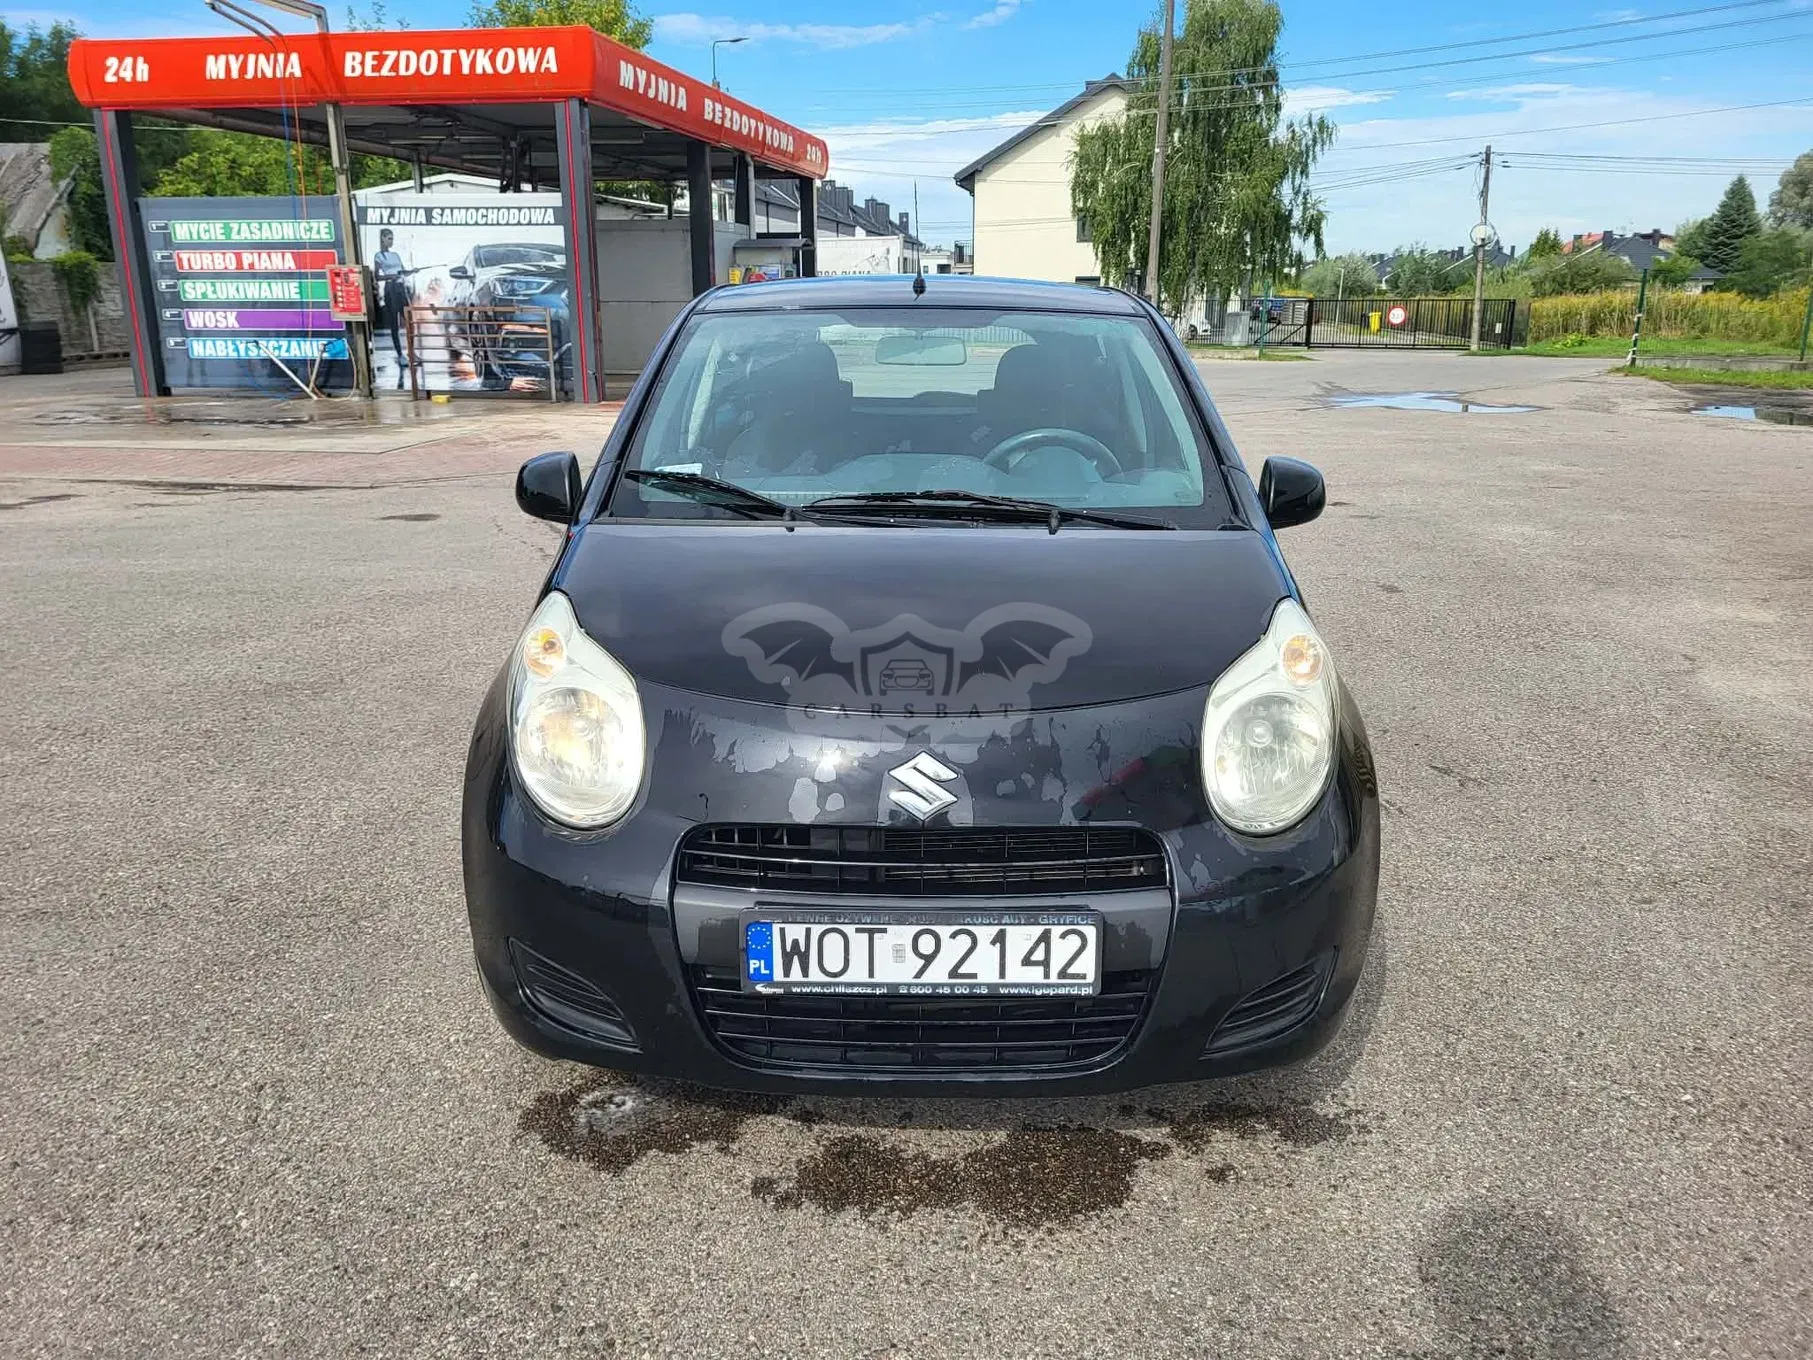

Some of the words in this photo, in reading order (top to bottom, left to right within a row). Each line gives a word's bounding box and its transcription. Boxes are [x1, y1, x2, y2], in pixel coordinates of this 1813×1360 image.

[104, 56, 149, 83] 24h
[205, 52, 302, 80] MYJNIA
[344, 46, 558, 77] BEZDOTYKOWA
[619, 60, 687, 112] MYJNIA
[703, 97, 794, 154] BEZDOTYKOWA
[806, 143, 823, 164] 24h
[366, 207, 427, 225] MYJNIA
[431, 207, 555, 225] SAMOCHODOWA
[174, 222, 227, 240] MYCIE
[230, 221, 332, 240] ZASADNICZE
[178, 252, 236, 270] TURBO
[242, 252, 297, 270] PIANA
[183, 281, 301, 300] SPŁUKIWANIE
[188, 310, 240, 328] WOSK
[1038, 914, 1096, 925] GRYFICE
[778, 926, 888, 979] WOT
[911, 927, 1089, 980] 92142
[750, 959, 770, 975] PL
[935, 985, 950, 995] 45
[954, 985, 970, 995] 00
[972, 985, 989, 995] 45
